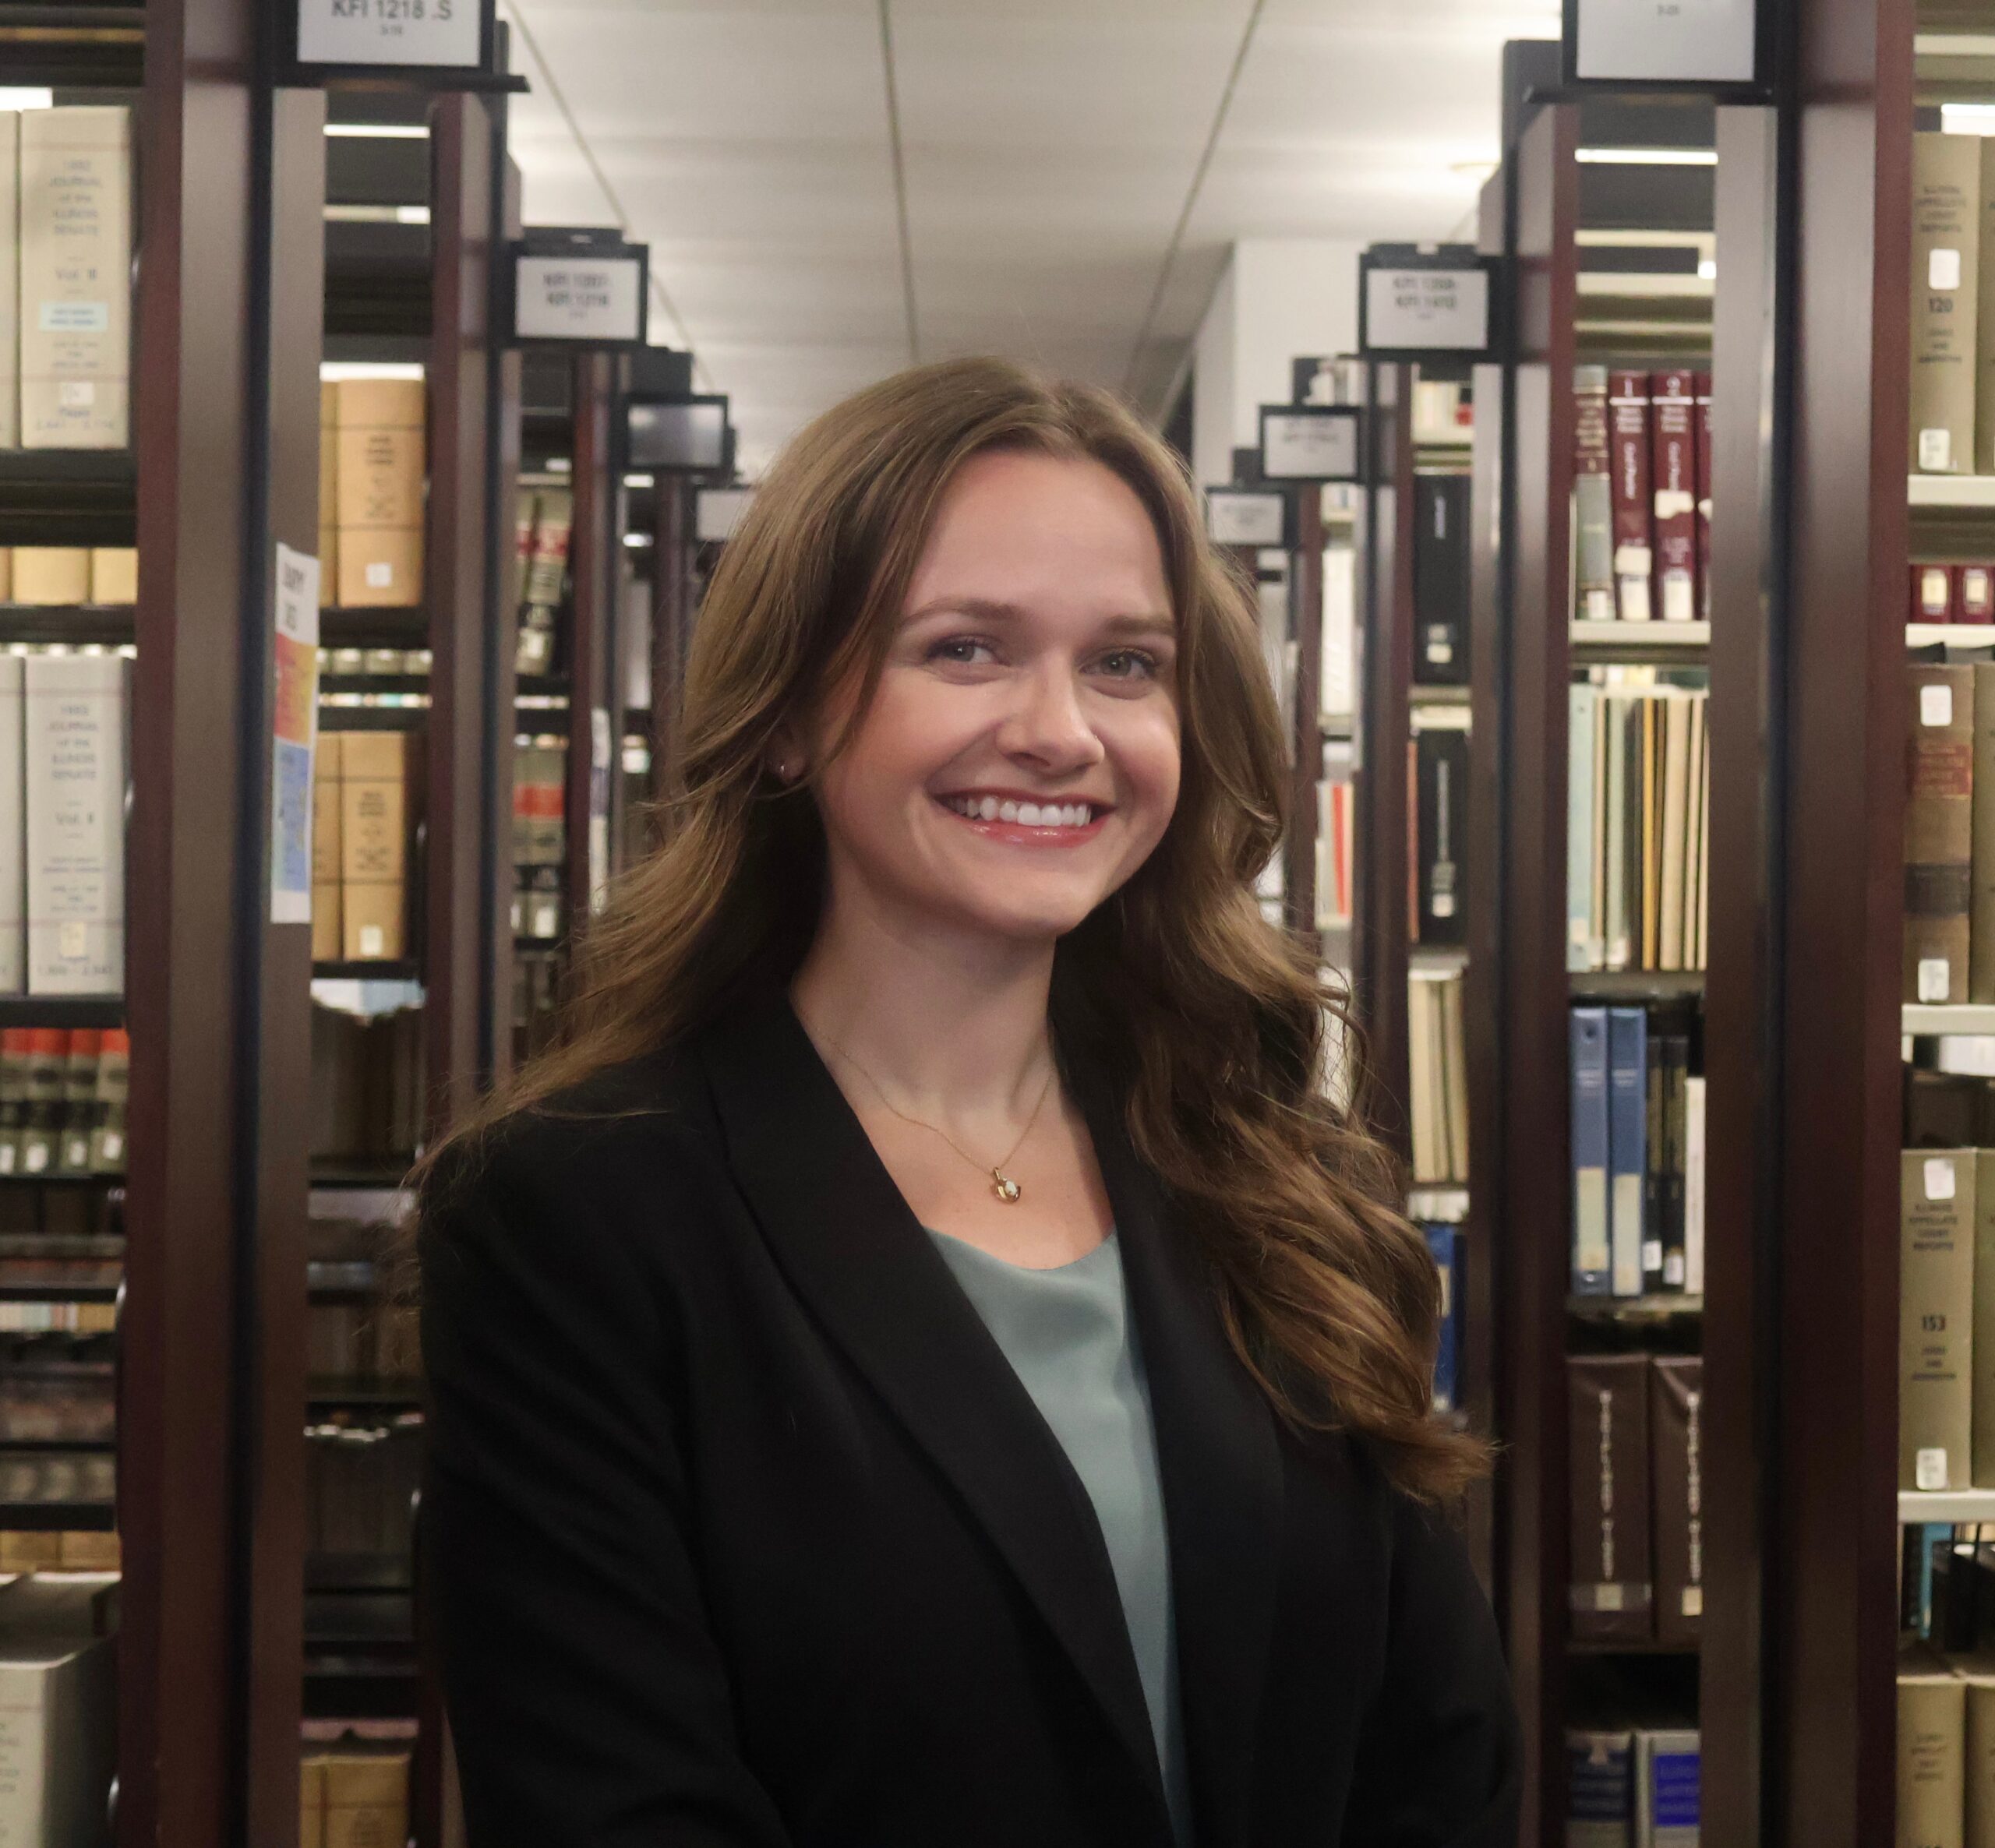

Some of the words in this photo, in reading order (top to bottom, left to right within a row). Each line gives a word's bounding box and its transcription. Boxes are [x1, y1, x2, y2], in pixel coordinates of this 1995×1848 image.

[331, 0, 368, 17] KFI
[378, 0, 424, 19] 1218
[1922, 1314, 1947, 1331] 153
